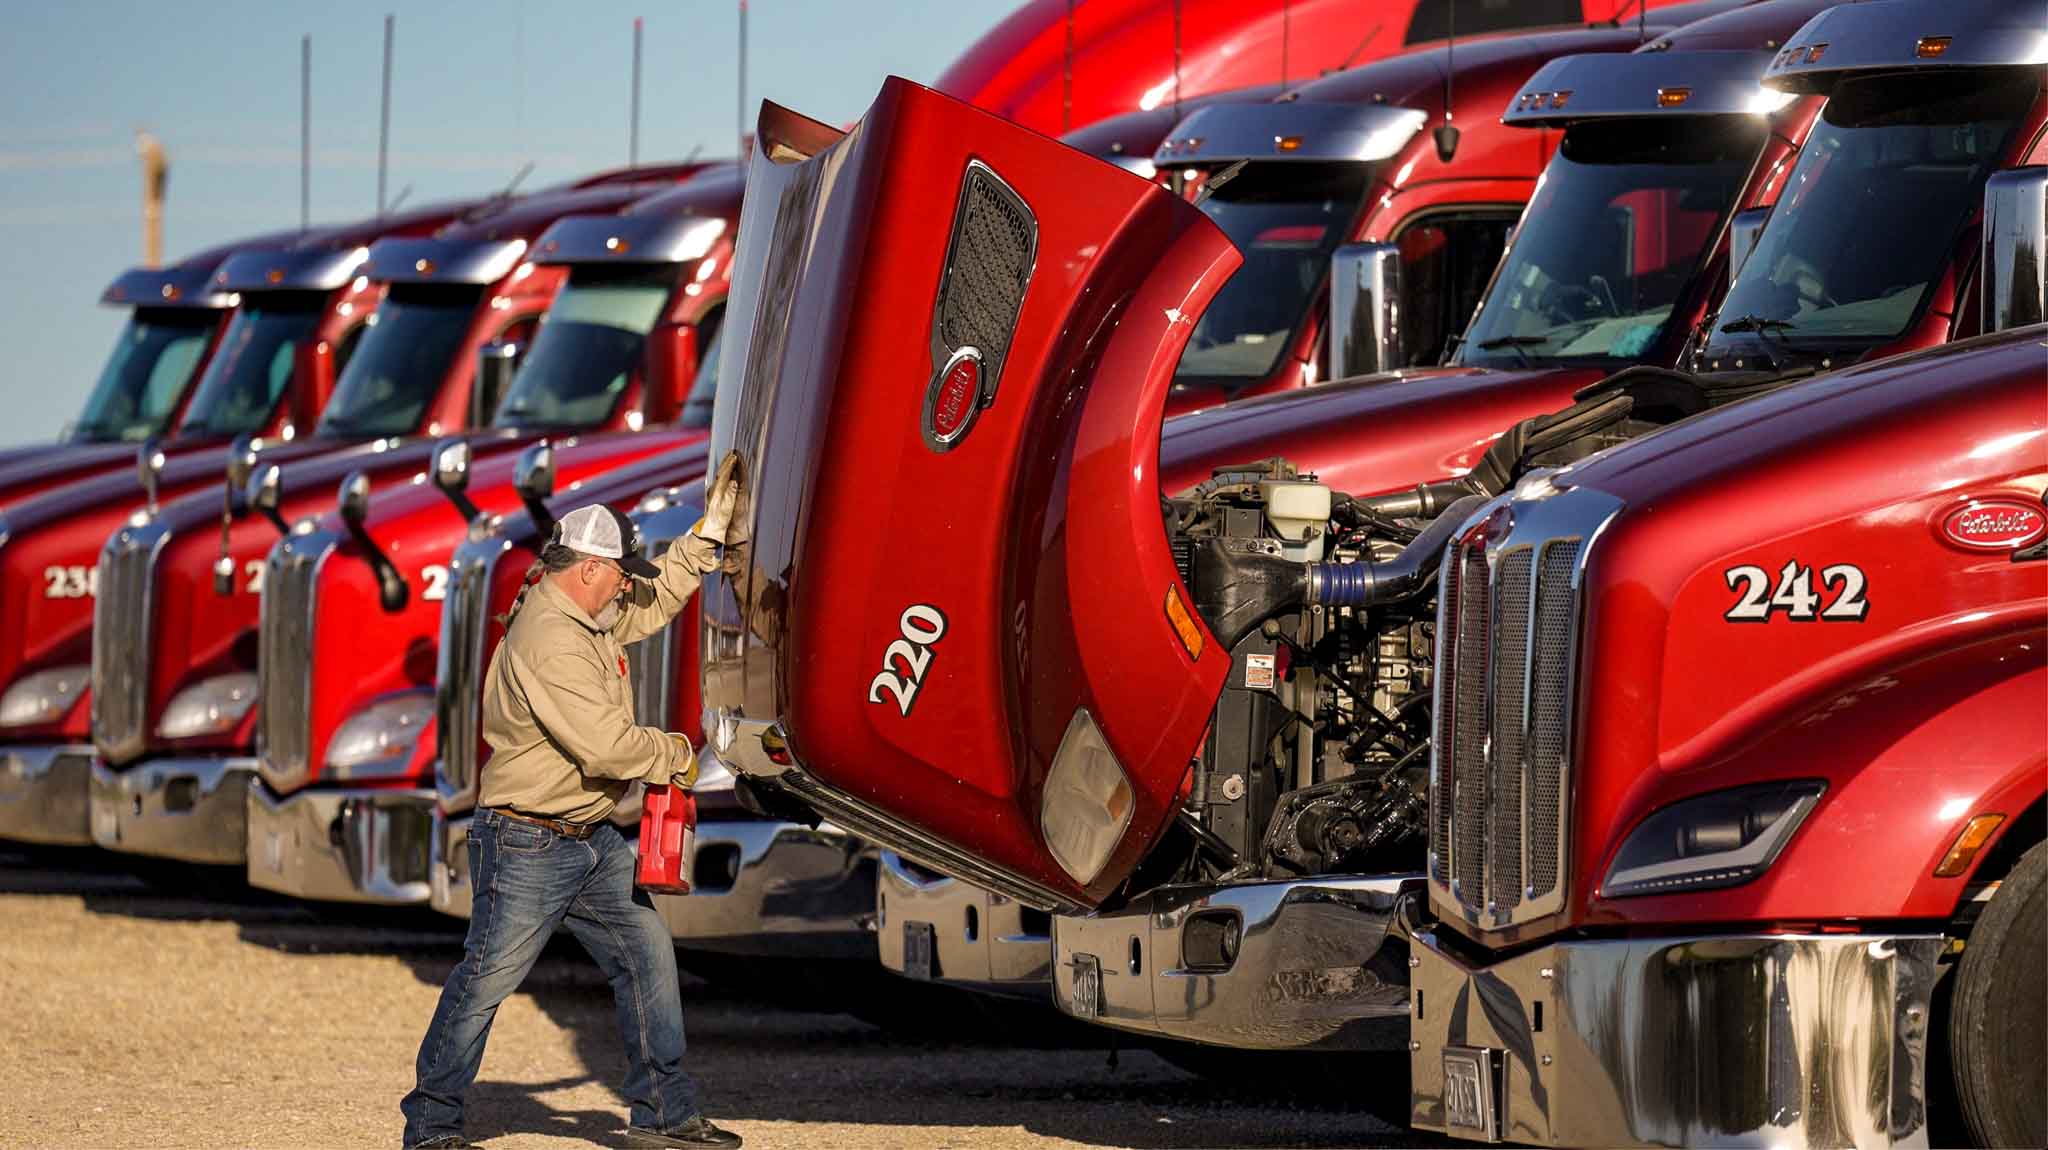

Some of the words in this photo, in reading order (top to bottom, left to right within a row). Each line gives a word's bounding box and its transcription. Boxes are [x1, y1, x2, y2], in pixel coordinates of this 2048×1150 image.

[1959, 512, 2034, 535] Peterbilt
[1724, 558, 1870, 623] 242
[868, 603, 949, 717] 220
